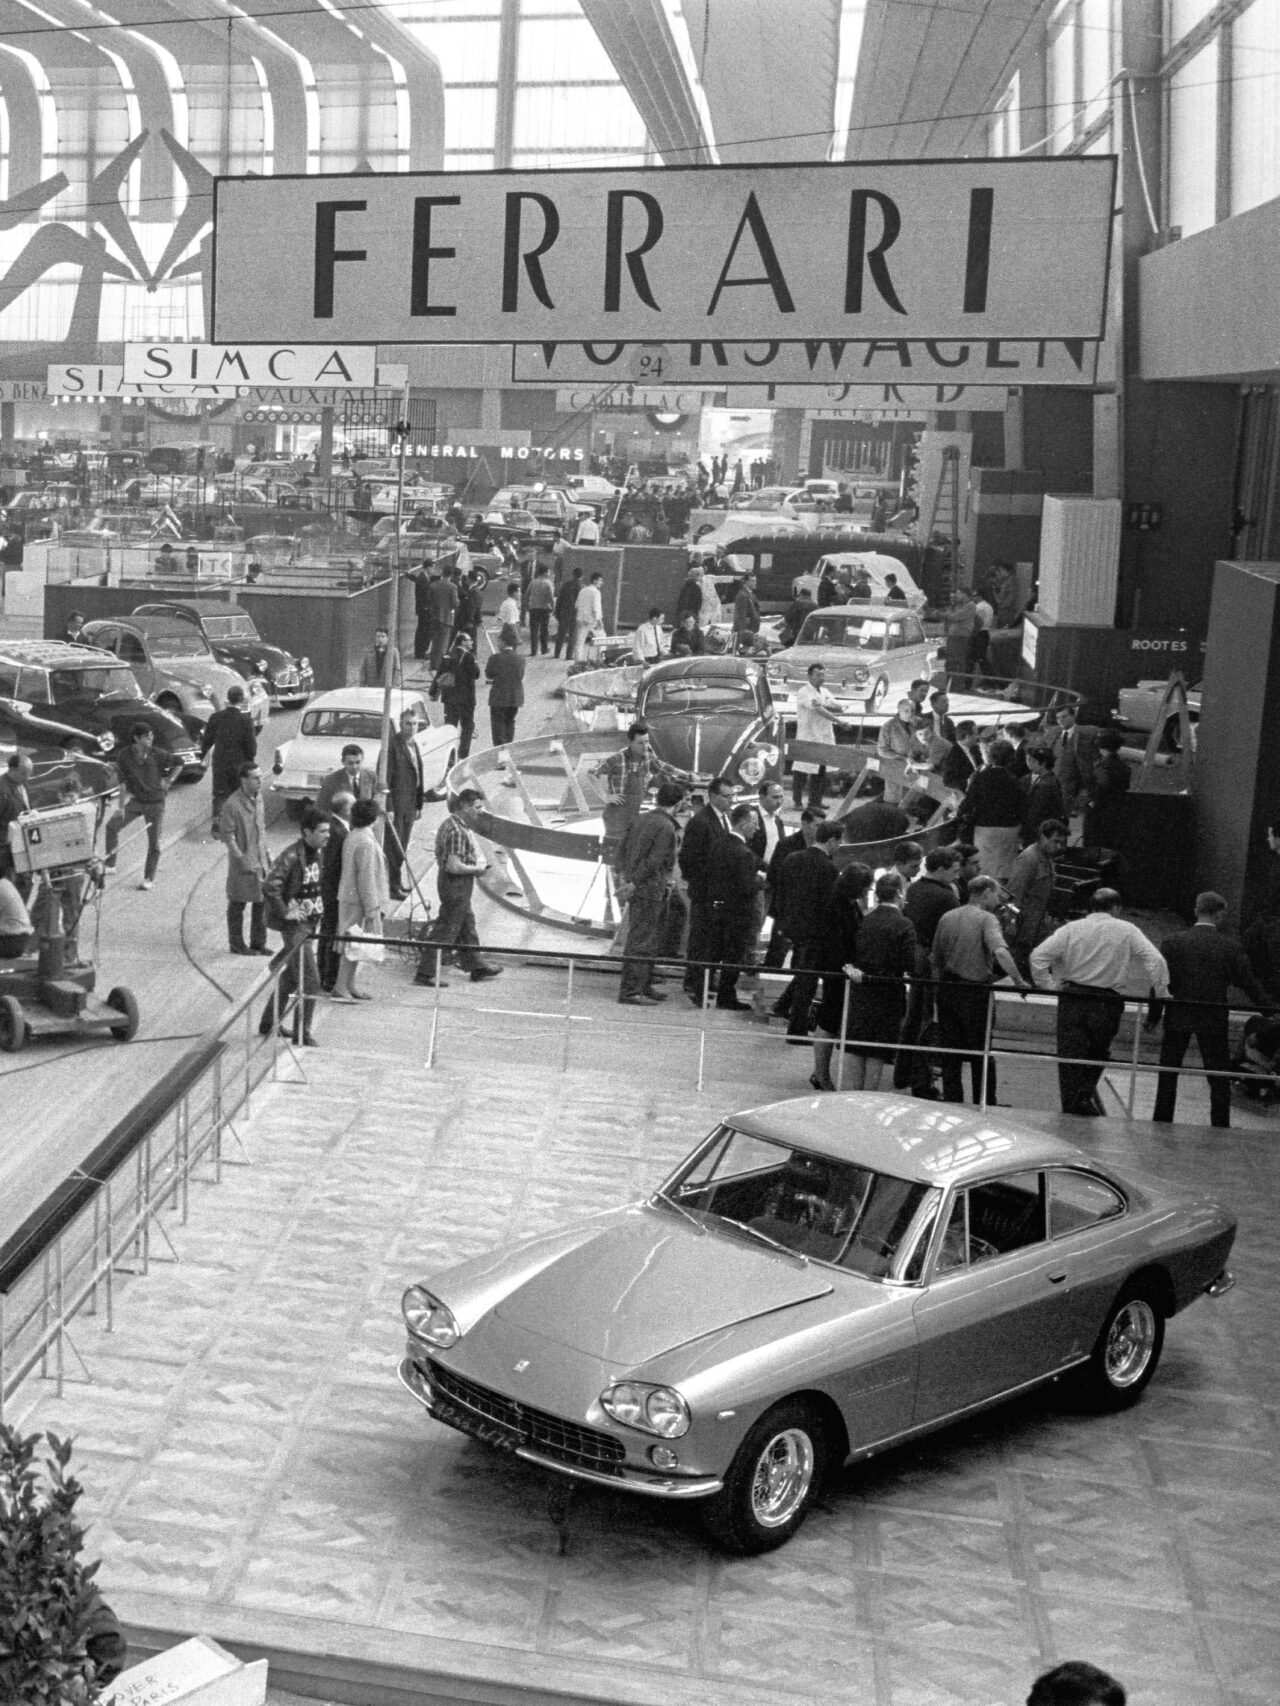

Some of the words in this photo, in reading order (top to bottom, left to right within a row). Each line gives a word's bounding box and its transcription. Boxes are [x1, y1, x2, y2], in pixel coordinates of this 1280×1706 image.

[313, 187, 994, 319] FERRARI
[144, 348, 352, 381] SIMCA
[639, 356, 663, 377] 24
[391, 443, 478, 458] GENERAL
[500, 447, 584, 460] MOTORS
[1132, 640, 1188, 652] ROOTES
